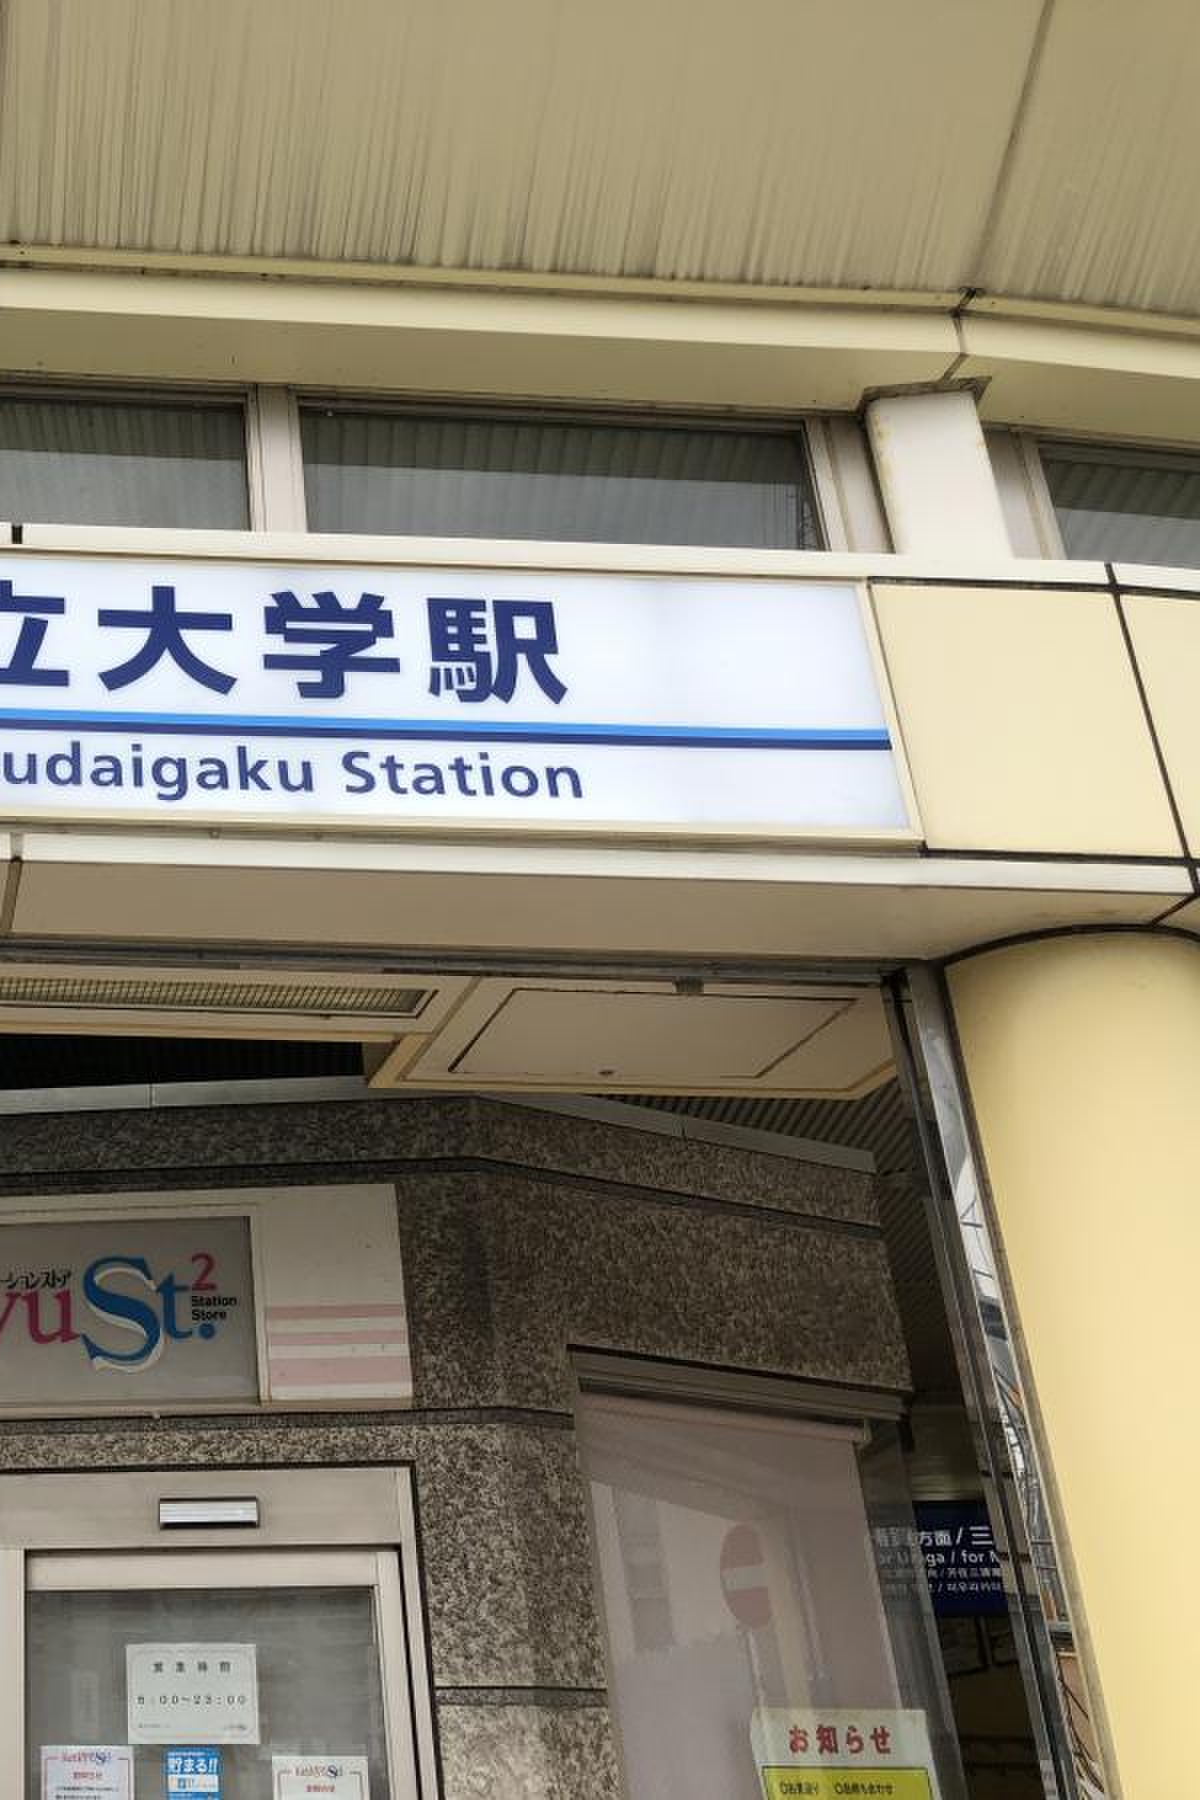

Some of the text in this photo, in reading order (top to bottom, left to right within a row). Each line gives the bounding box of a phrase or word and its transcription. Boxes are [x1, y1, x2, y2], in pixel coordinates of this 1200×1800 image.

[340, 749, 585, 800] Station
[191, 1295, 238, 1308] Station
[191, 1308, 227, 1321] Store
[788, 1724, 892, 1755] お知らせ
